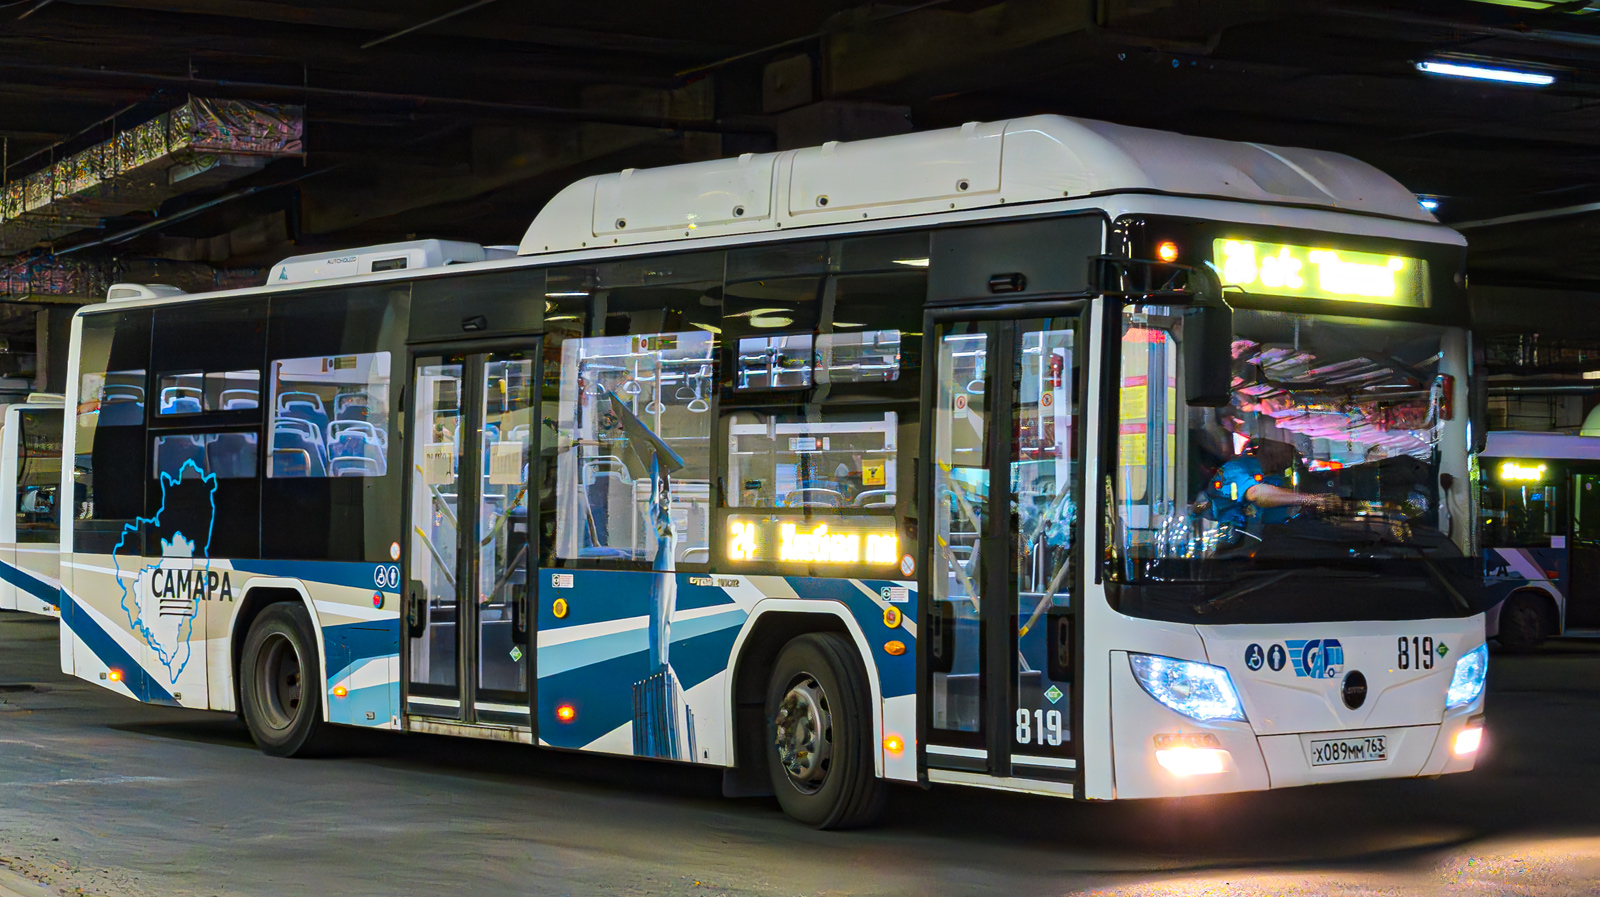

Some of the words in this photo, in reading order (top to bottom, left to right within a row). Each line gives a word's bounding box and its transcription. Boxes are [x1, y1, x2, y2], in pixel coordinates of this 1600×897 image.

[731, 522, 758, 560] 24
[151, 568, 233, 603] САМАРА
[1398, 636, 1434, 670] 819
[1016, 708, 1062, 746] 819
